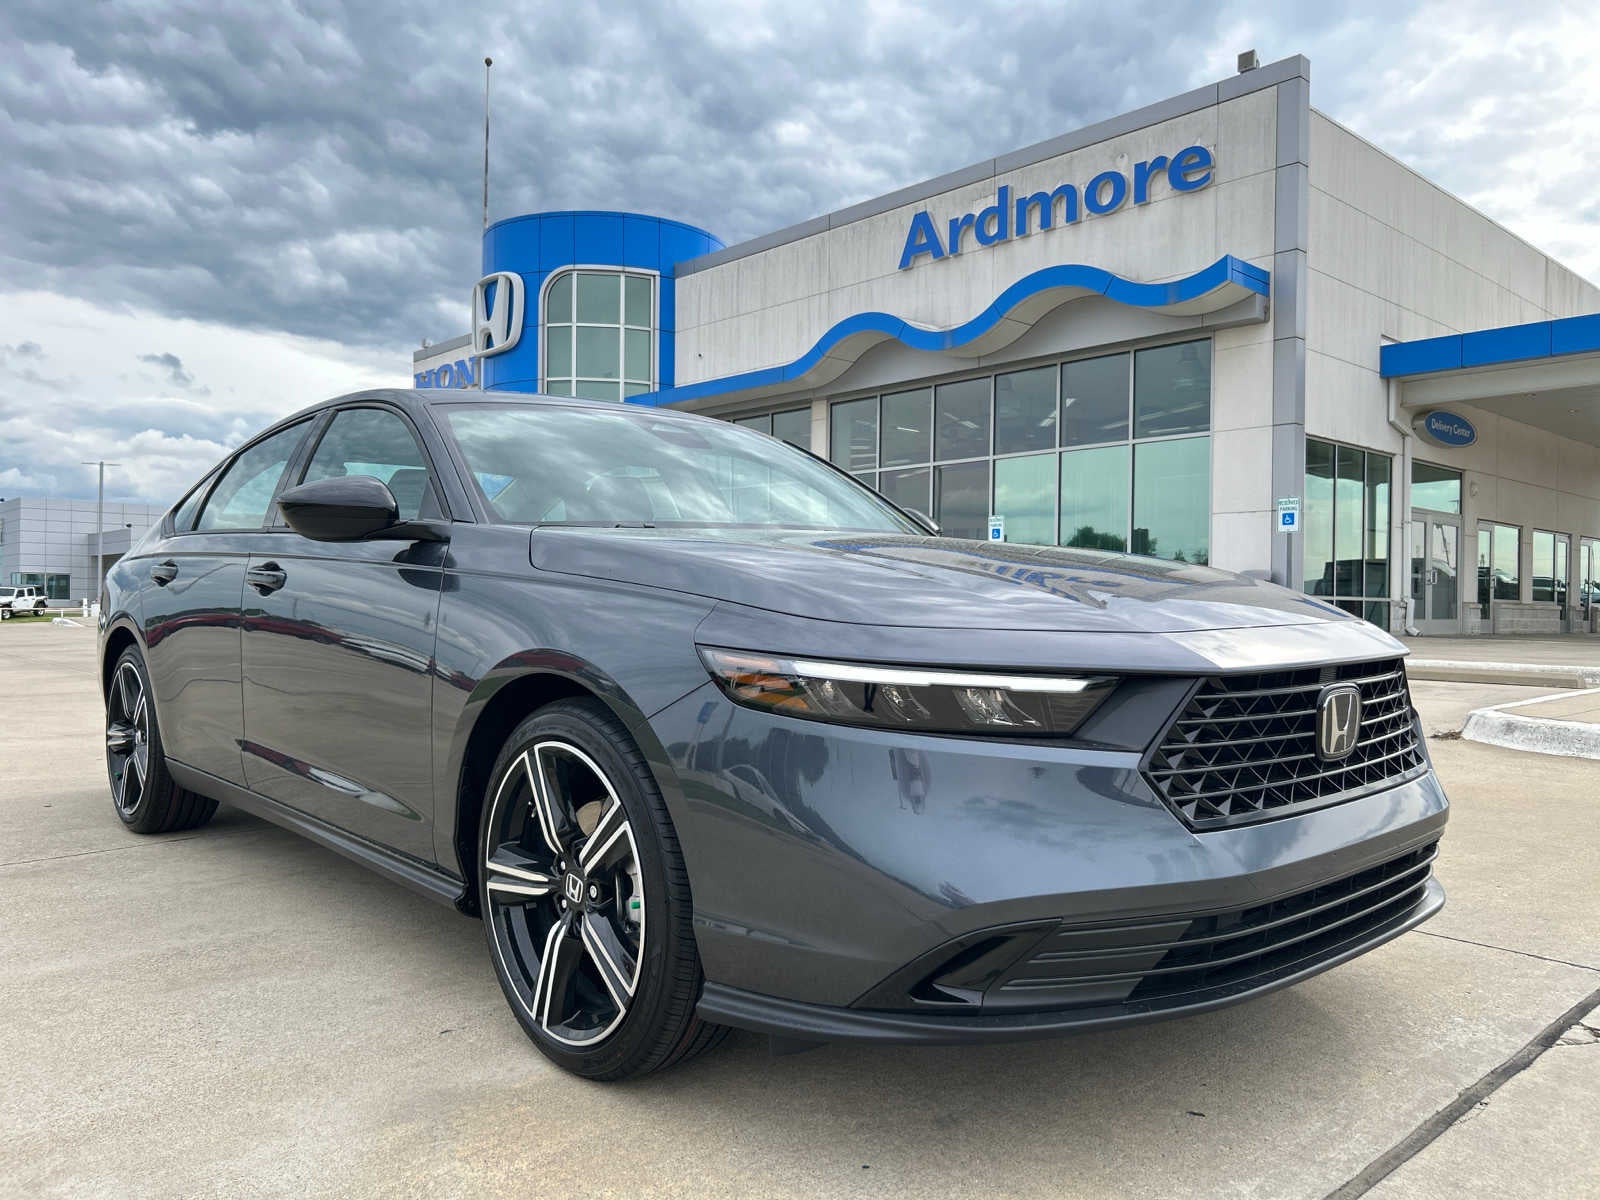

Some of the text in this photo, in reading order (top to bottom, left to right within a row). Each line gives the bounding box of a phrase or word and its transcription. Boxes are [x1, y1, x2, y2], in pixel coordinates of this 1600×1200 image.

[898, 145, 1213, 270] Ardmore
[1431, 418, 1471, 437] Delivery Center
